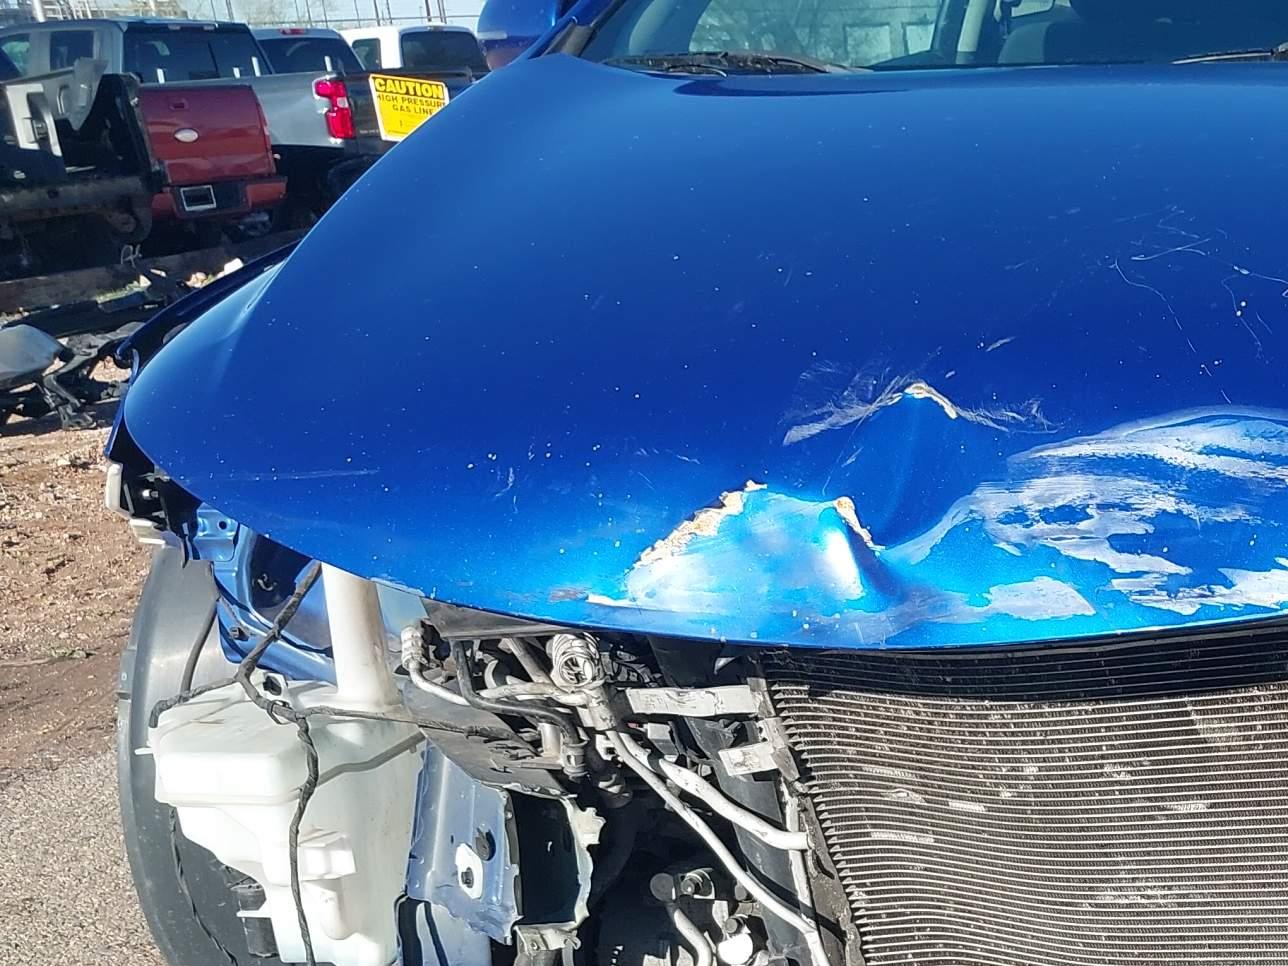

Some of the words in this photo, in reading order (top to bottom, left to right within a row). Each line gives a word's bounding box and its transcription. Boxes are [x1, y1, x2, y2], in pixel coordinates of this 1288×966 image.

[374, 78, 443, 99] CAUTION
[377, 94, 398, 102] HIGH
[392, 104, 411, 113] GAS
